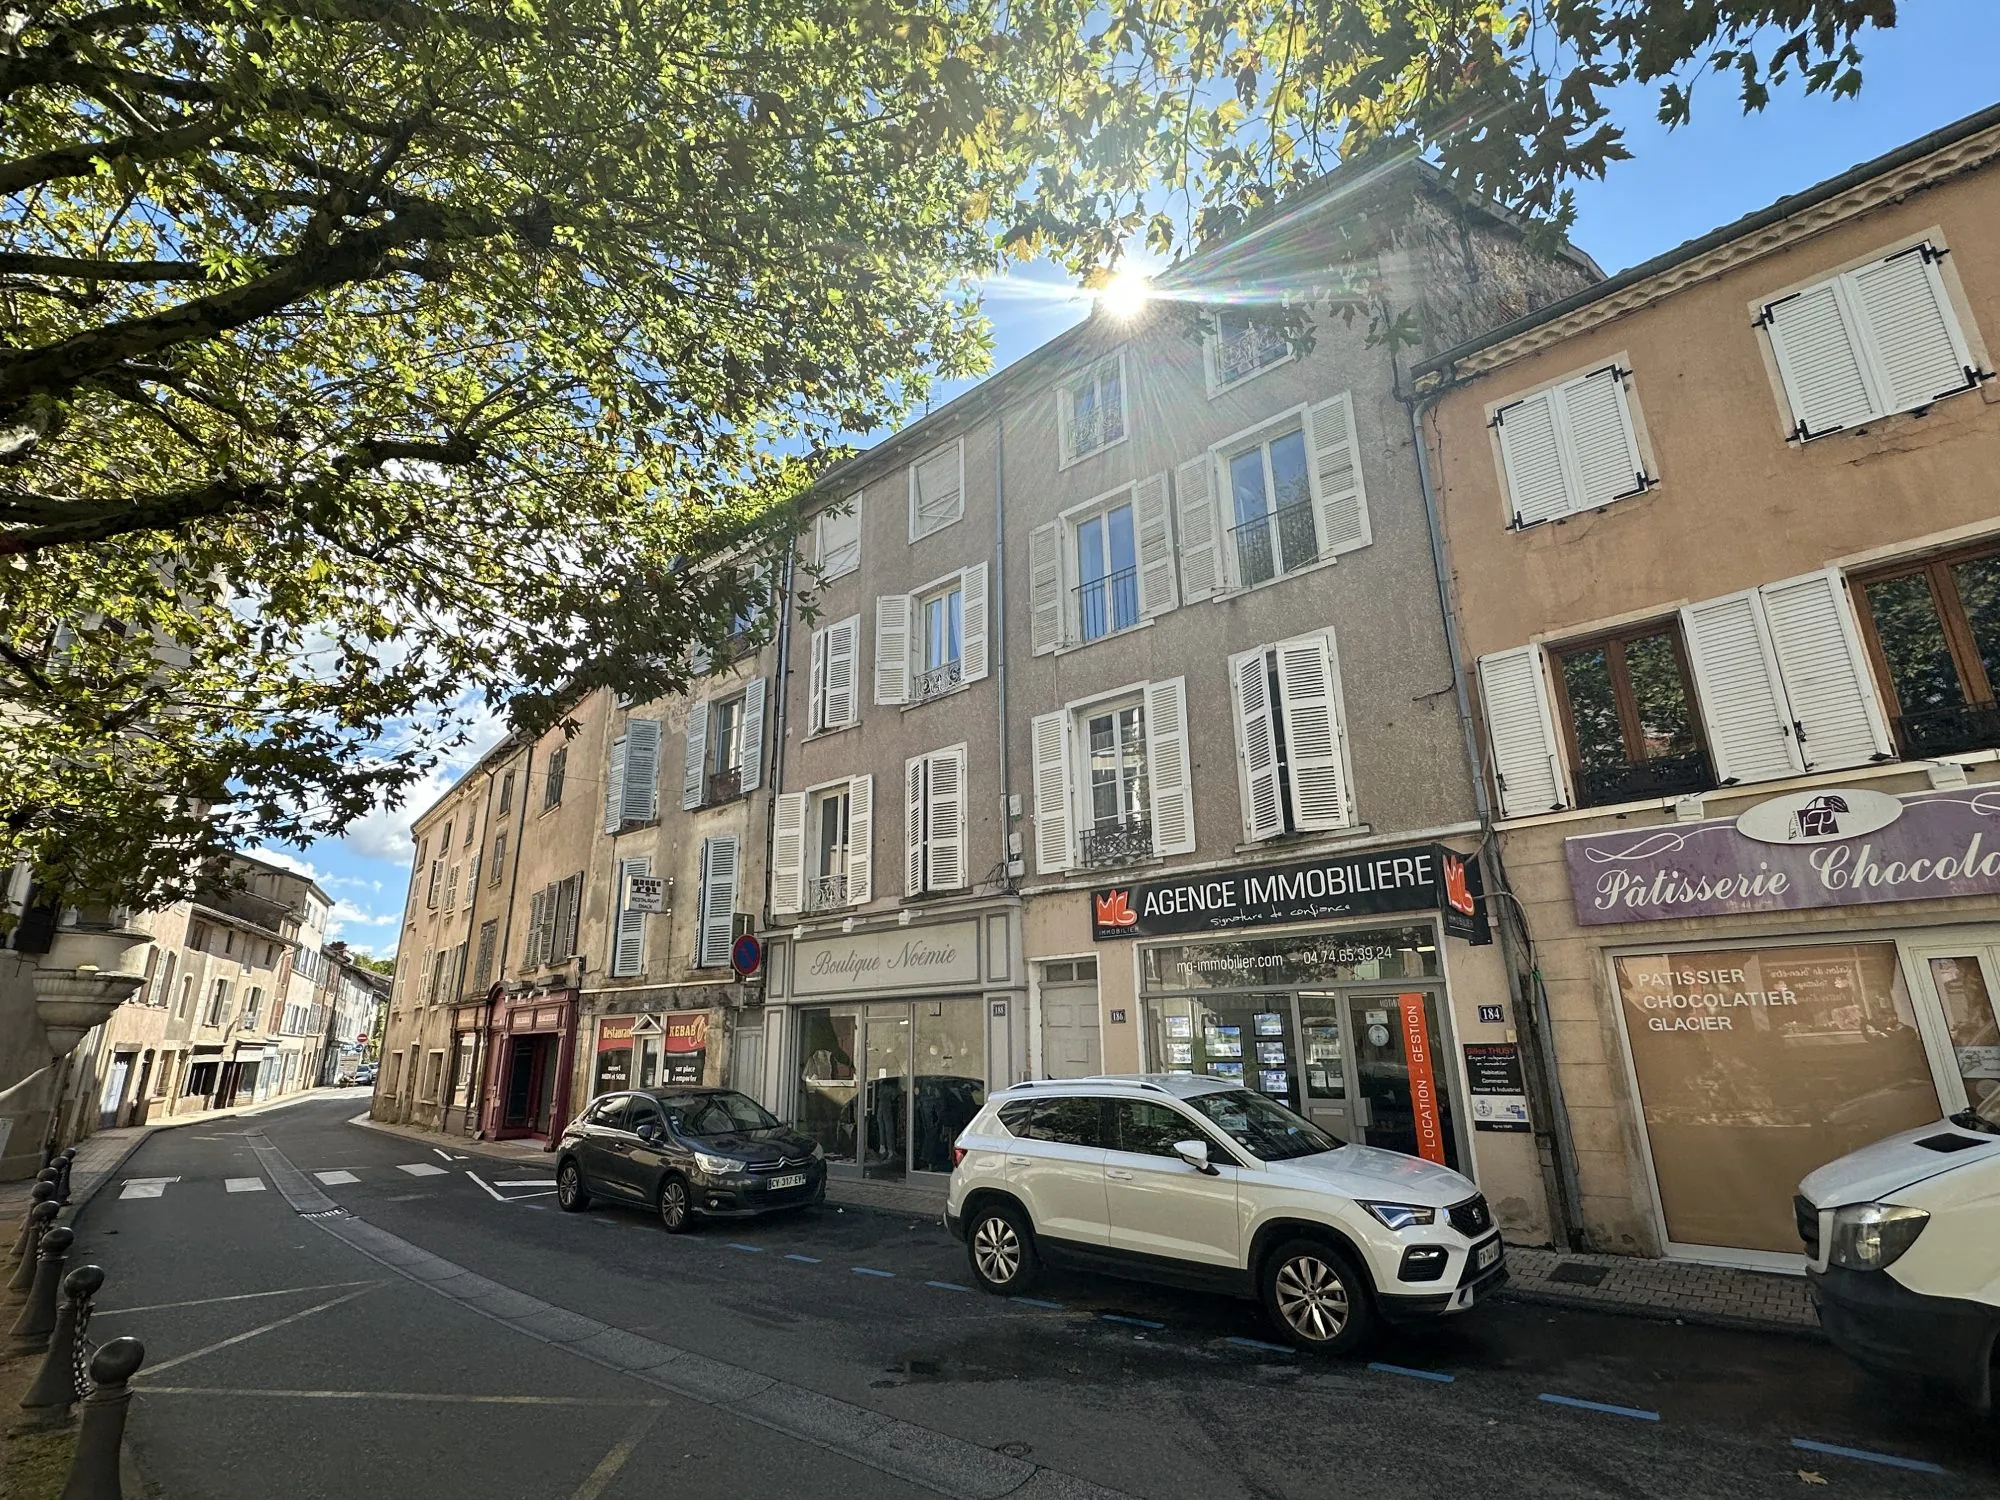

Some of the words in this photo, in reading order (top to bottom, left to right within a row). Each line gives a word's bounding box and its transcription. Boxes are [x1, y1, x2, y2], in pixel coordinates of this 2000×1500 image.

[1143, 881, 1237, 917] AGENCE
[1243, 854, 1434, 906] IMMOBILIERE
[1594, 862, 1790, 910] Pâtisserie
[1210, 908, 1263, 926] signature
[1270, 904, 1282, 918] de
[1290, 903, 1351, 917] confiance
[1098, 925, 1140, 936] IMMOBILIER
[810, 949, 880, 982] Boutique
[887, 940, 957, 969] Noémie
[1176, 954, 1283, 975] mg-immobilier.com
[1303, 945, 1393, 965] 04.74.65.39.24
[1638, 968, 1745, 987] PATISSIER
[1643, 990, 1798, 1009] CHOCOLATIER
[1113, 1011, 1124, 1021] 186
[1483, 1008, 1500, 1020] 184
[669, 1024, 697, 1037] KEBAB
[1648, 1016, 1734, 1032] GLACIER
[1407, 1005, 1424, 1063] GESTION
[683, 1065, 696, 1073] place
[1416, 1080, 1436, 1148] LOCATION
